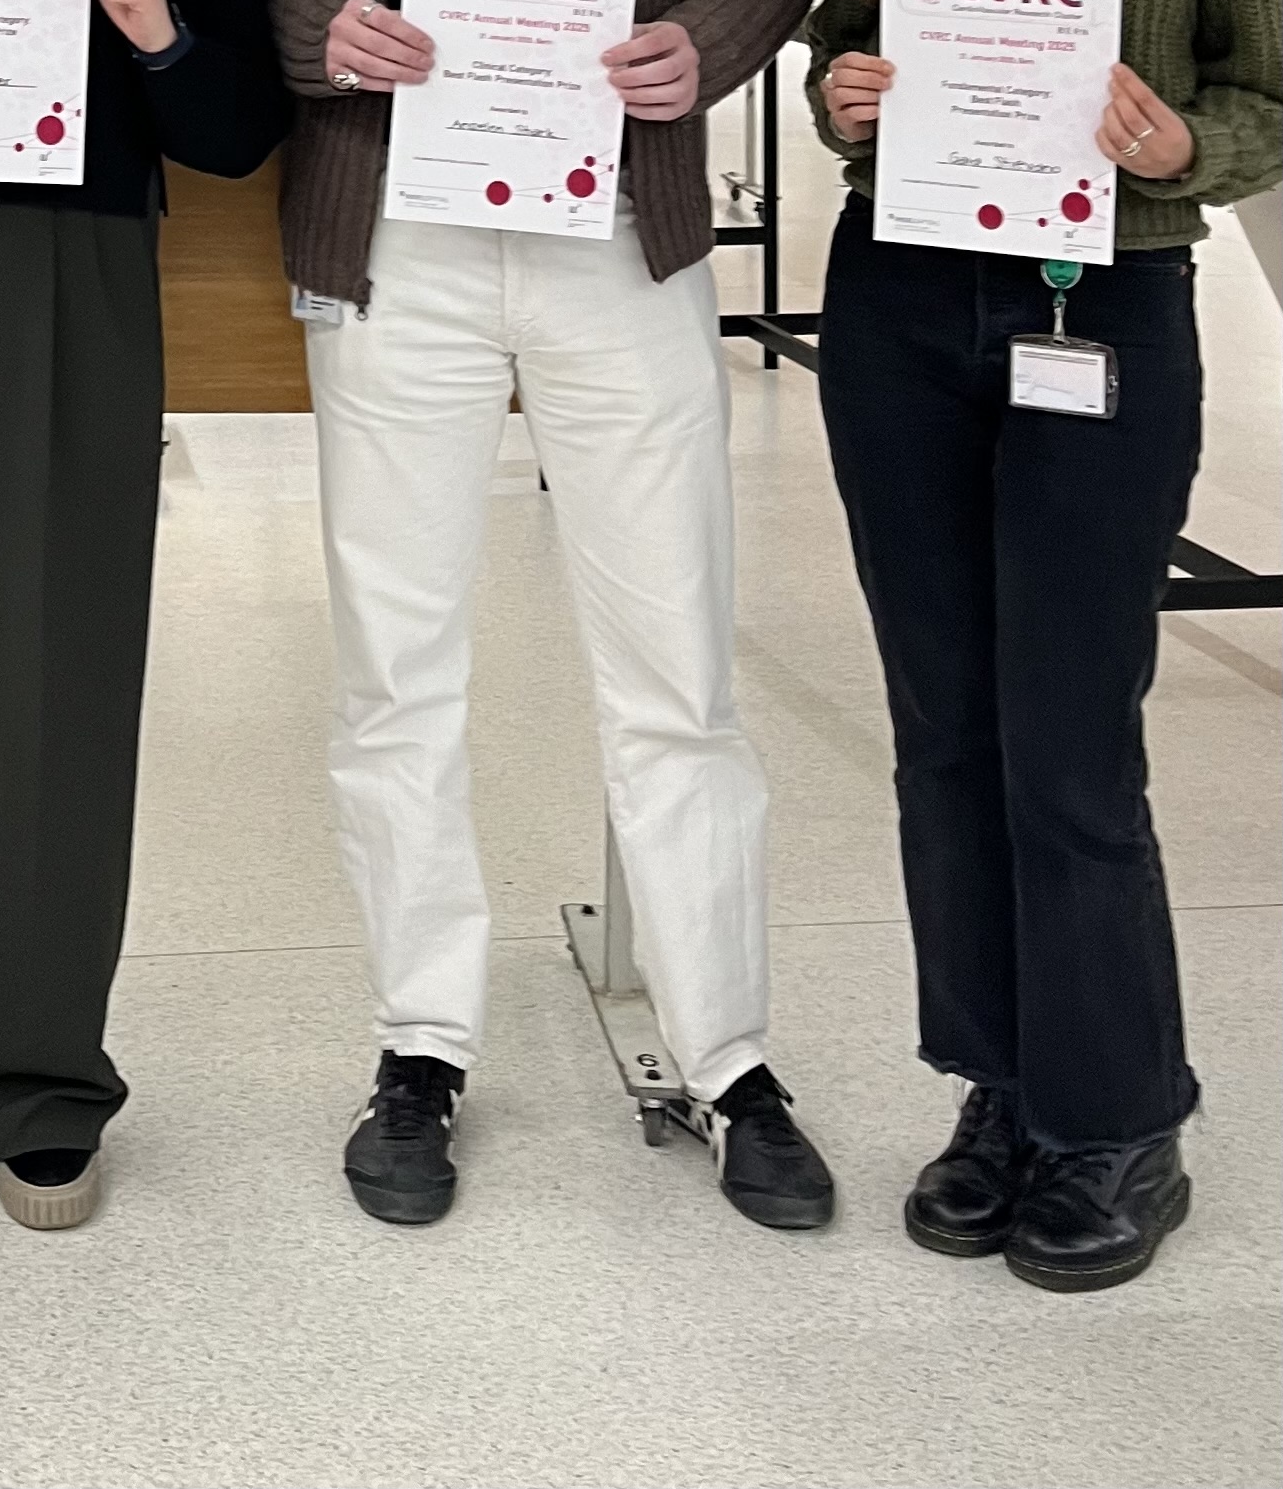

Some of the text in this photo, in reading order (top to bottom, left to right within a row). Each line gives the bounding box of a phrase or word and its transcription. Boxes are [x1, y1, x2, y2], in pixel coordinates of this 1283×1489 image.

[439, 10, 591, 33] CVRC Annual Meeting 2025
[919, 30, 1077, 52] CVRC Annual Meeting 2025
[637, 1054, 660, 1068] 6
